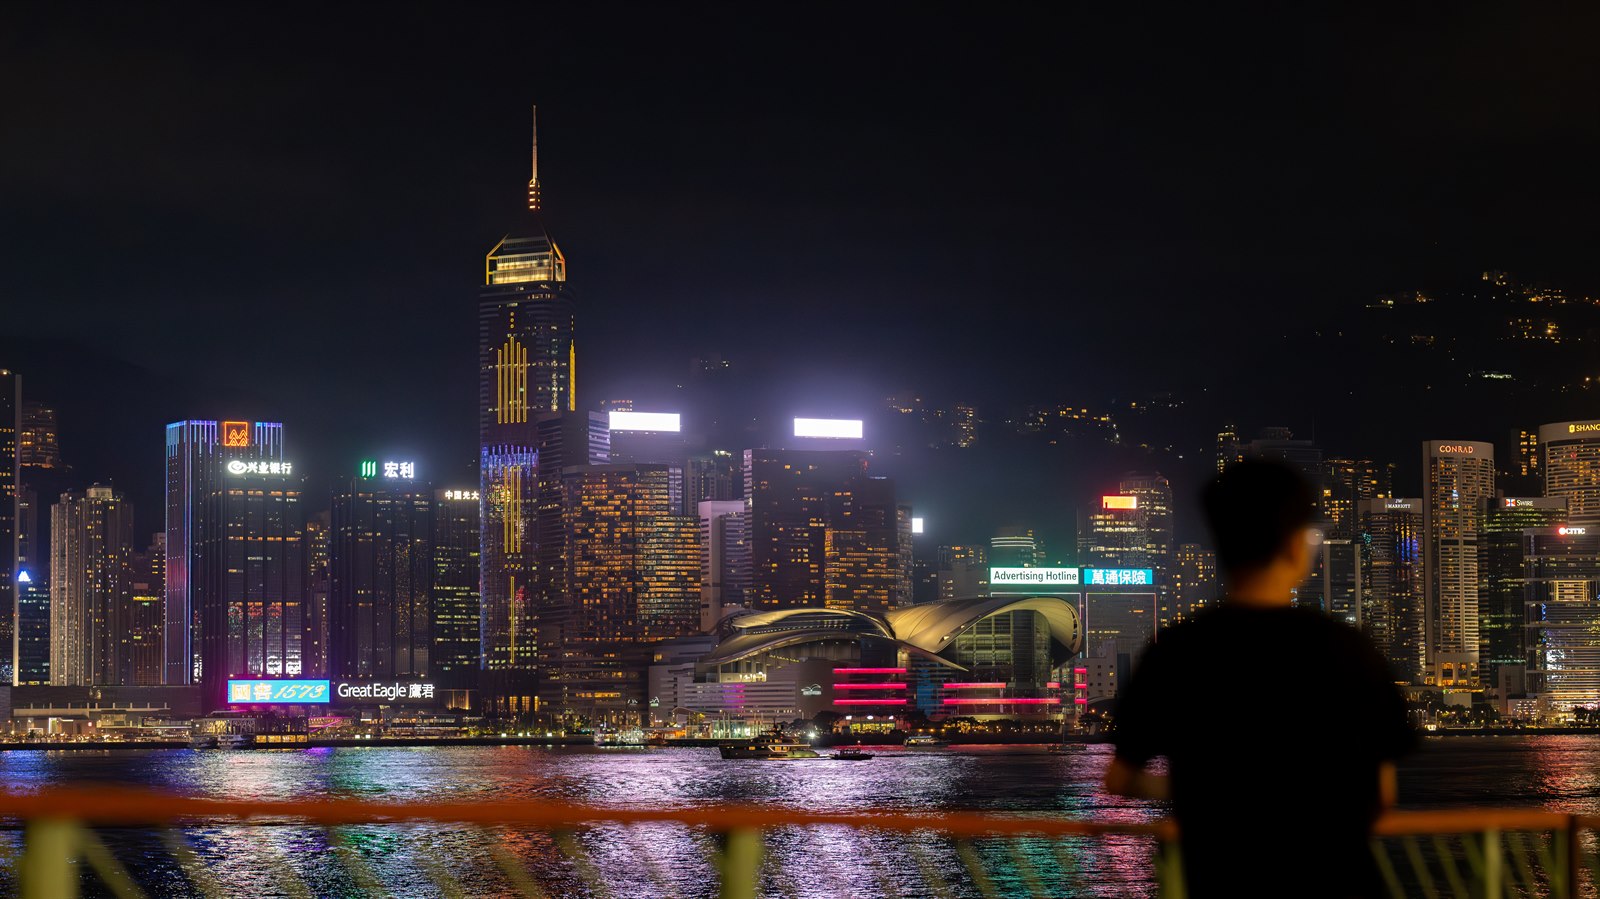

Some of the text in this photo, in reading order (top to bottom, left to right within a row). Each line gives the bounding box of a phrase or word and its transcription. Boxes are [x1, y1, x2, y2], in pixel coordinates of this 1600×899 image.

[1440, 445, 1473, 453] CONRAD
[247, 461, 292, 474] 兴业银行
[384, 461, 414, 478] 宏利
[445, 490, 480, 500] 中国光大
[994, 571, 1077, 582] Advertising Hotline
[1091, 569, 1147, 584] 萬通保險
[274, 685, 326, 698] 1573
[338, 683, 435, 700] Great Eagle 鷹君
